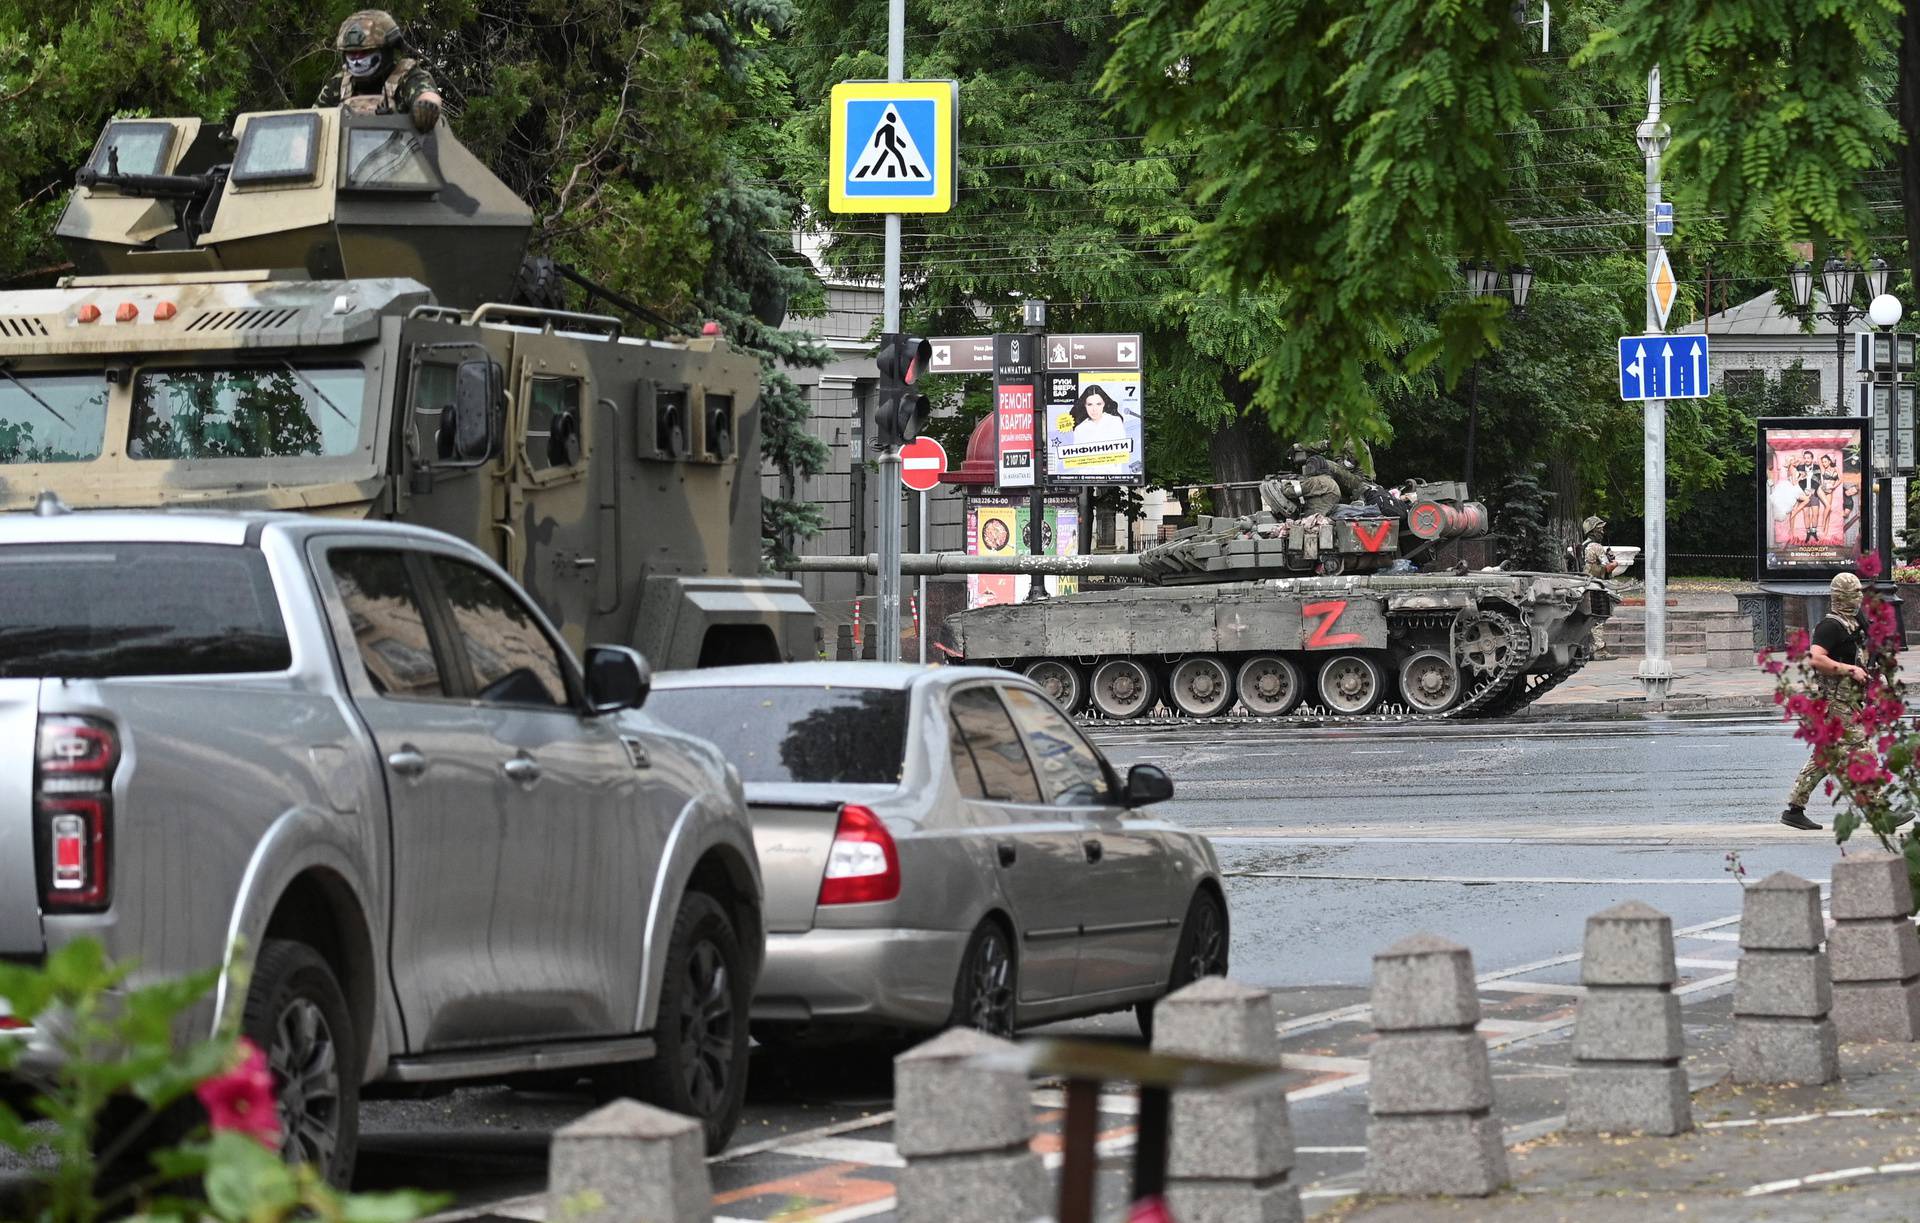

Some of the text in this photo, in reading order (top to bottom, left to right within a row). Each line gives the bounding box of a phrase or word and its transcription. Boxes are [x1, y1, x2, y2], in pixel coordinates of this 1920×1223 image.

[1000, 366, 1032, 375] MANHATTAN
[1124, 386, 1136, 397] 7
[1000, 392, 1032, 409] РЕМОНТ
[1000, 412, 1032, 431] КВАРТИР
[1062, 442, 1128, 456] ИНФИНИТИ
[1006, 454, 1010, 466] 2
[1302, 600, 1362, 648] Z
